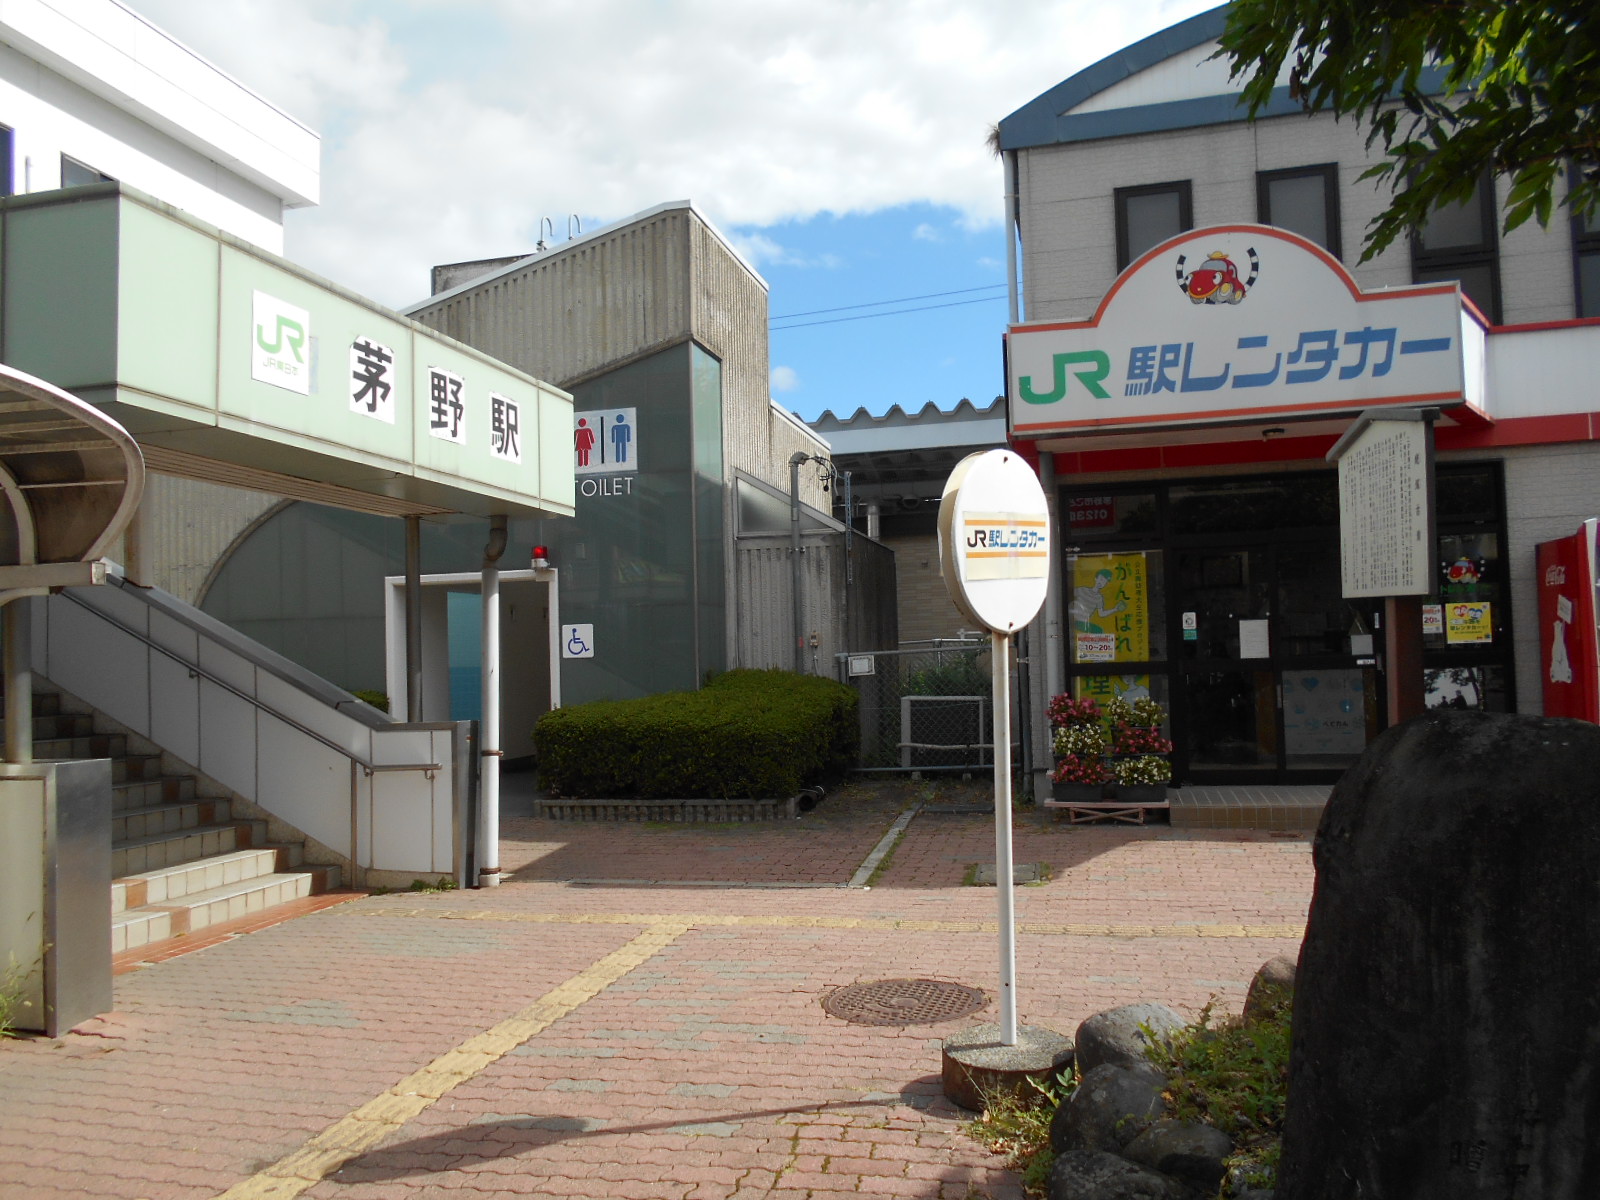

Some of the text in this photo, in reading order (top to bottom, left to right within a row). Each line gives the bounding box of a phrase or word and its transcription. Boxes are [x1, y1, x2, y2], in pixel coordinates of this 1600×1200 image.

[256, 314, 305, 364] JR
[1018, 326, 1452, 405] JR 駅レンタカー
[352, 340, 520, 458] 茅野駅
[967, 530, 1046, 548] JR 駅レンタカー
[1114, 561, 1133, 653] がんばれ
